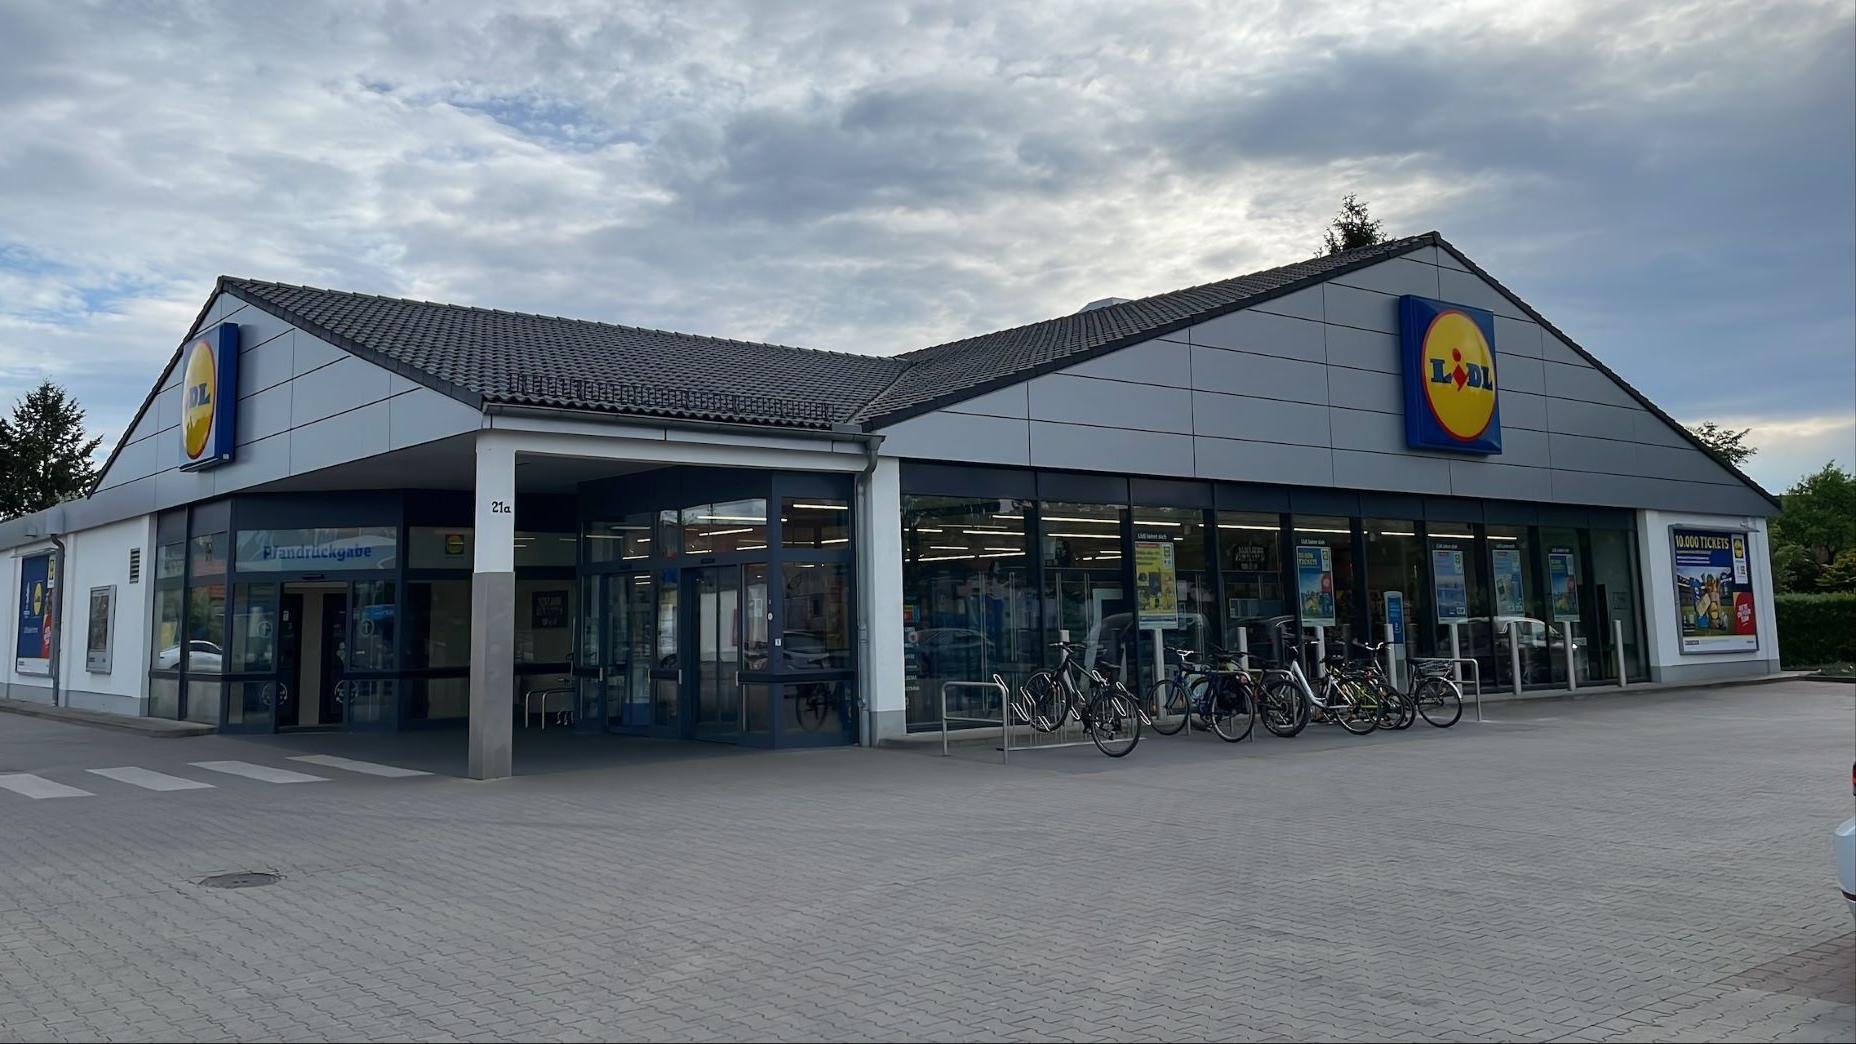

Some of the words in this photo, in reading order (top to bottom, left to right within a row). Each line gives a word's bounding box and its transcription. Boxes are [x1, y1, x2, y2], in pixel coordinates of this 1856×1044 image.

[491, 501, 511, 513] 21a
[1675, 534, 1699, 549] 10.000
[1700, 536, 1729, 550] TICKETS
[263, 544, 372, 561] Pfandrückgabe
